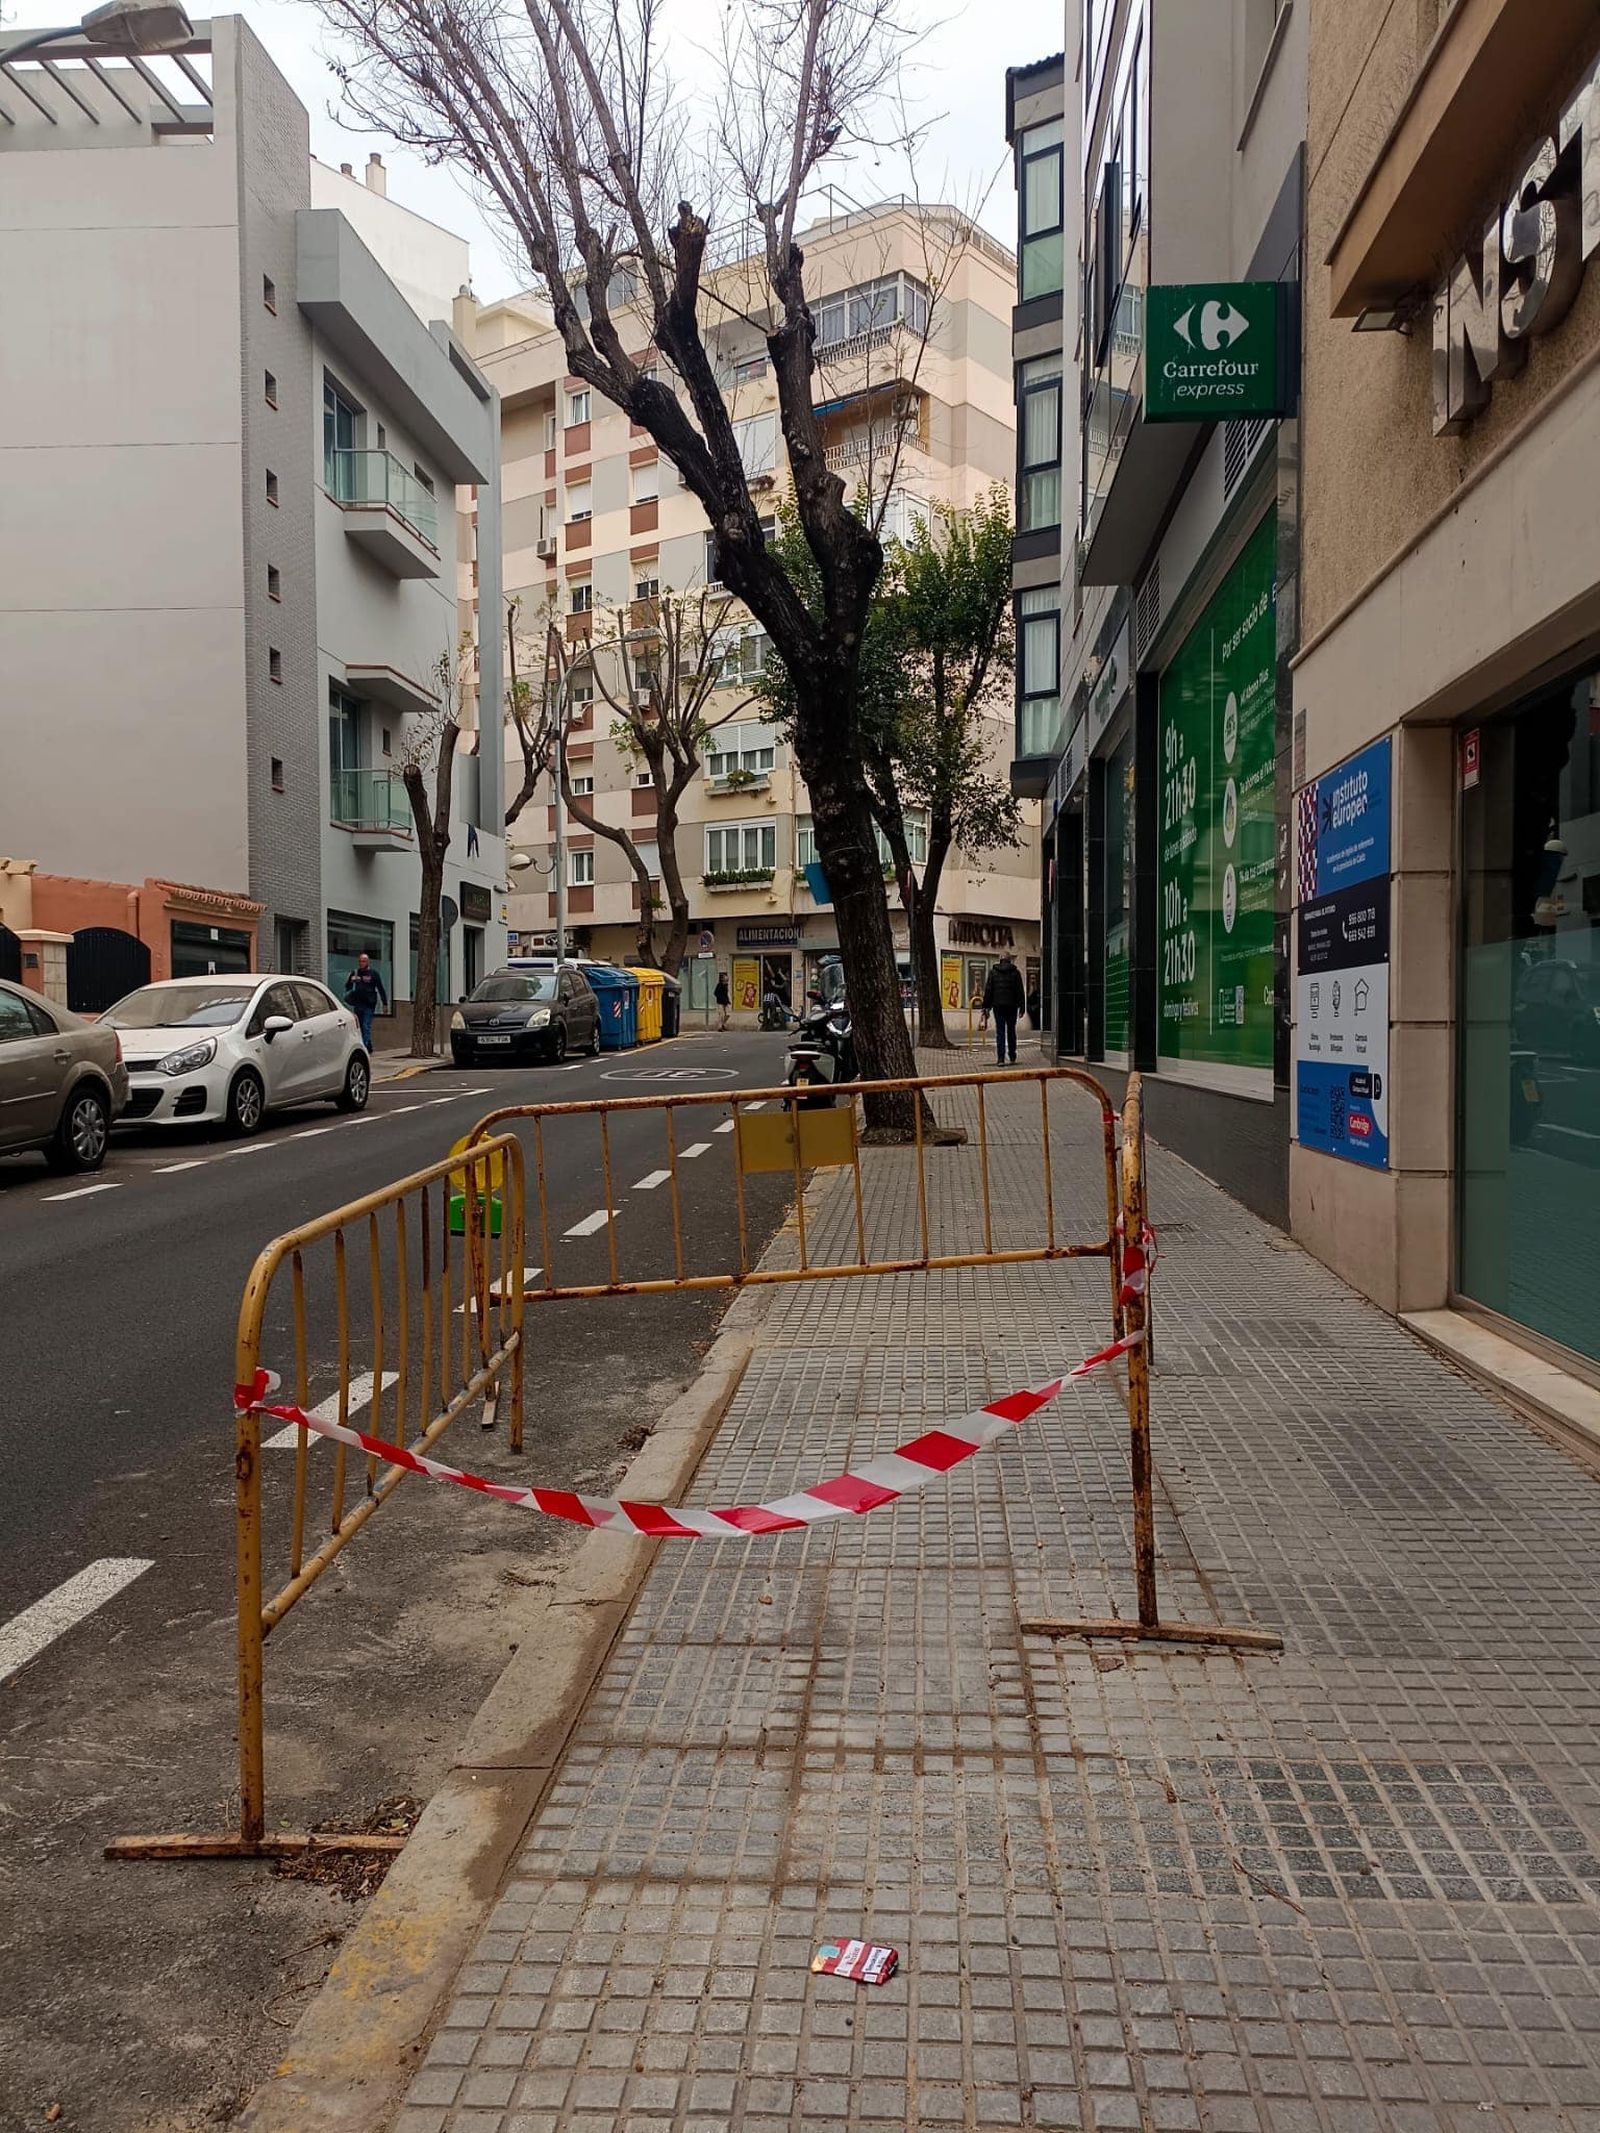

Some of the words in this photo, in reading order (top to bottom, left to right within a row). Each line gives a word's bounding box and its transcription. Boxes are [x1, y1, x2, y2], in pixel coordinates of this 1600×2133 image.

[1163, 359, 1259, 378] Carrefour
[1177, 383, 1245, 400] express
[1242, 602, 1258, 639] socio
[1259, 591, 1268, 616] de
[1165, 718, 1178, 774] 9h
[1178, 733, 1184, 759] a
[1165, 756, 1196, 832] 21h30
[1332, 770, 1368, 808] instituto
[1164, 877, 1181, 930] 10h
[1183, 897, 1188, 922] a
[739, 927, 800, 941] ALIMENTACION
[1164, 930, 1196, 986] 21h30
